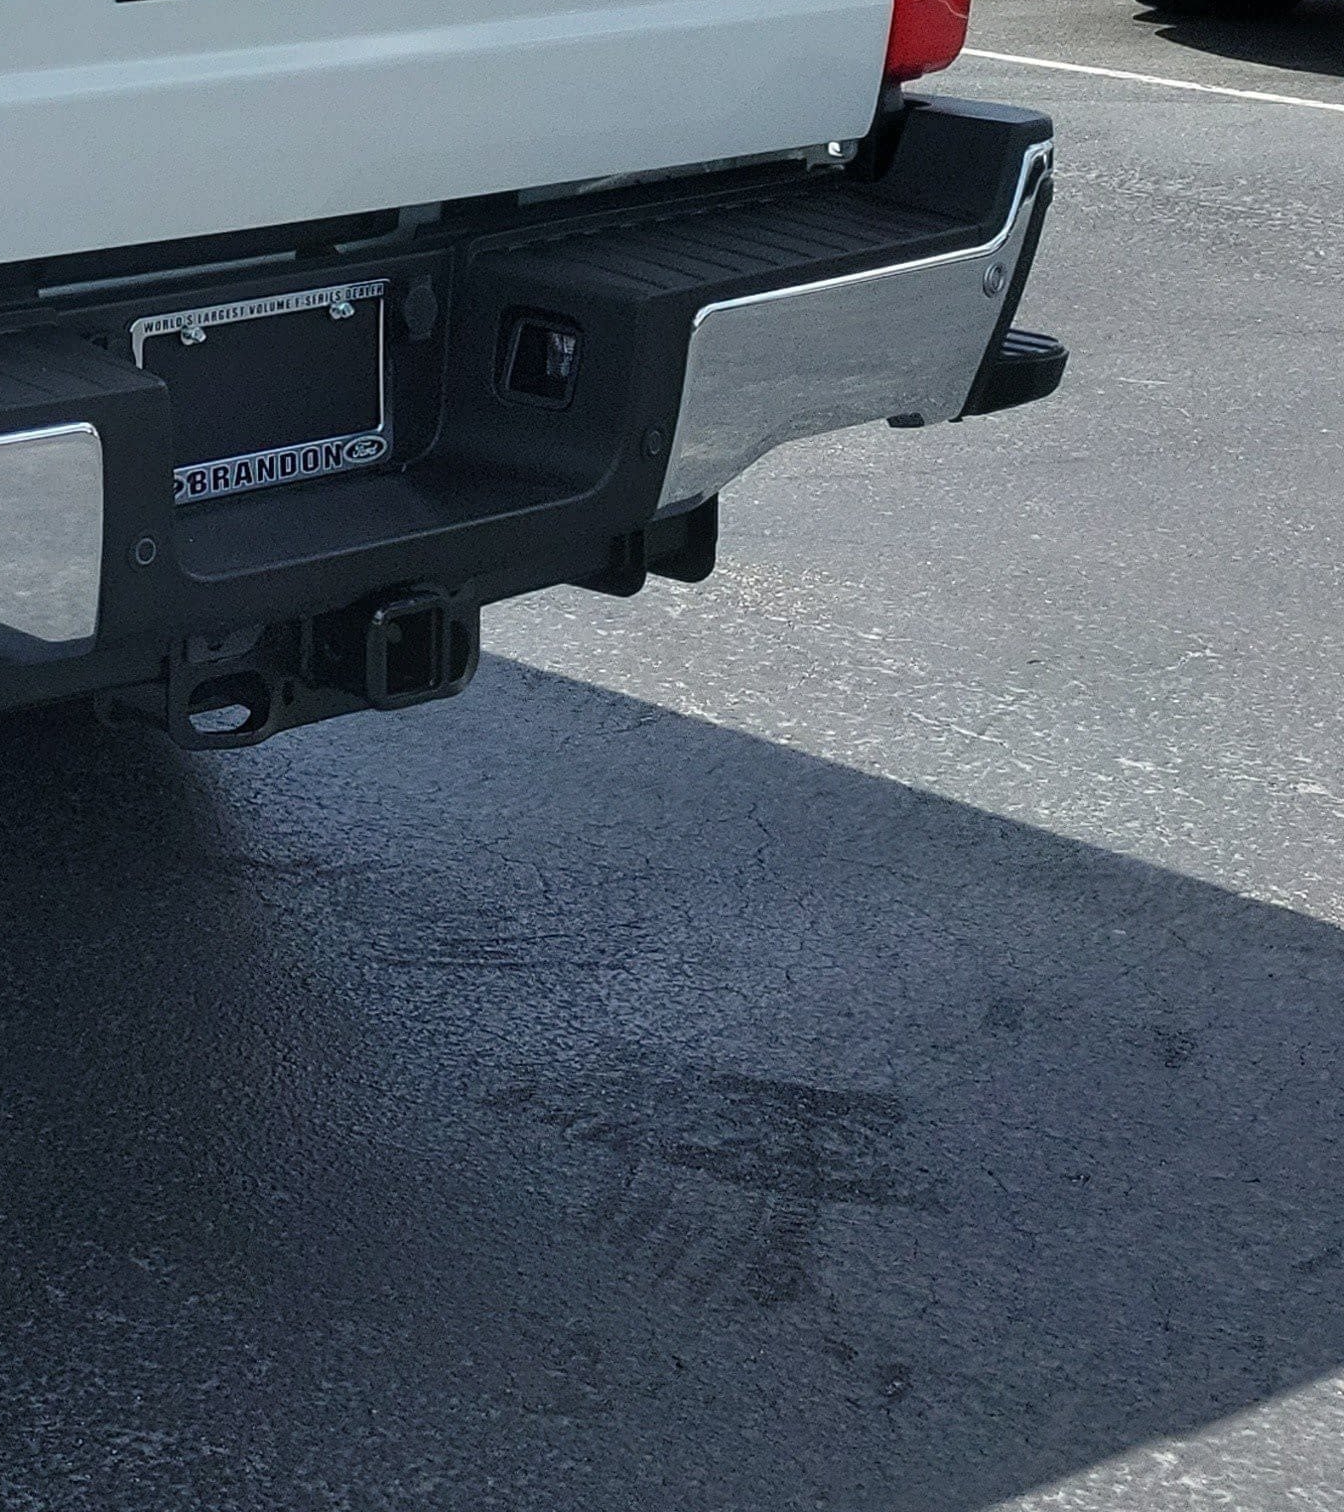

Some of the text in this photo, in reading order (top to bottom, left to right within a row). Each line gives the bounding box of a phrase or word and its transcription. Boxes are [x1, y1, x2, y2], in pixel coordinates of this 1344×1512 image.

[197, 305, 246, 325] LARGEST
[249, 299, 291, 315] VOLUME
[187, 440, 379, 498] BRANDON Ford
